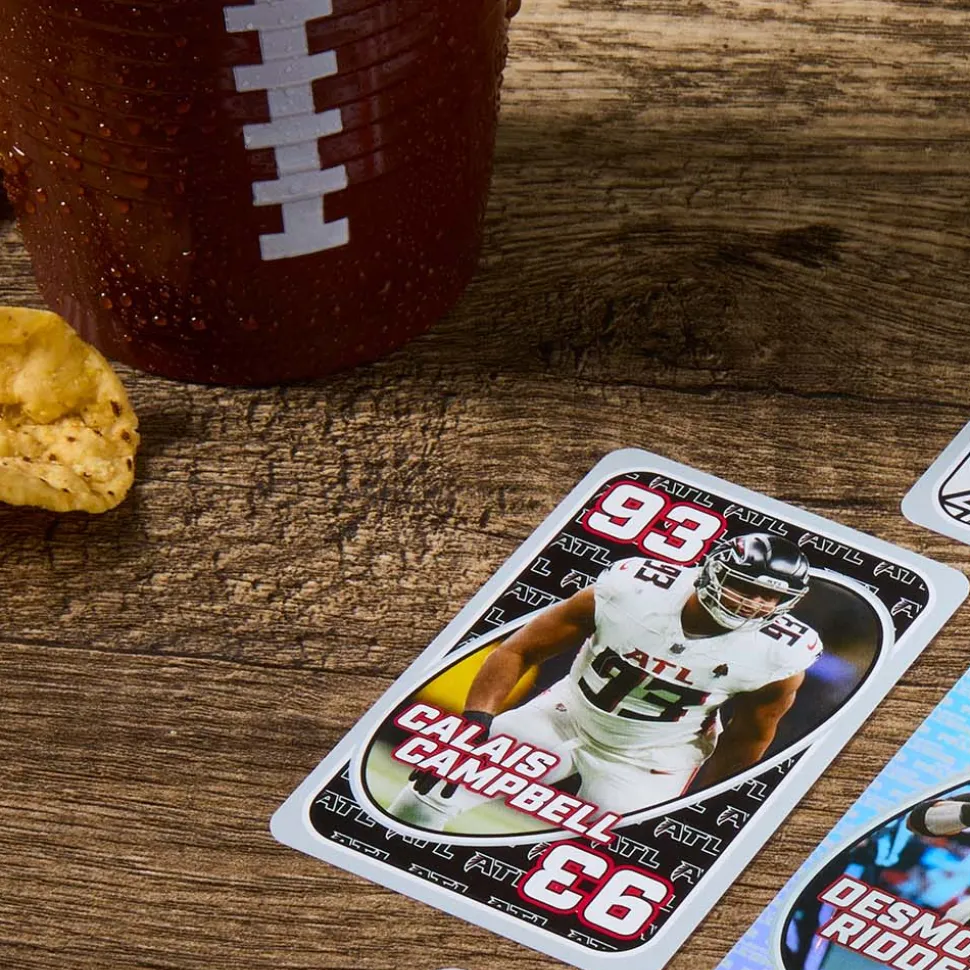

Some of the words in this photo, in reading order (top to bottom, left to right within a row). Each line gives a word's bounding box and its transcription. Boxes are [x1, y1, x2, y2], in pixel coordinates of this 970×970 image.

[550, 532, 612, 567] ATL
[585, 482, 725, 565] 93
[623, 648, 694, 685] ATL
[397, 704, 558, 779] CALAIS
[394, 737, 620, 843] CAMPBELL
[654, 816, 722, 856] ATL
[522, 844, 672, 938] 93
